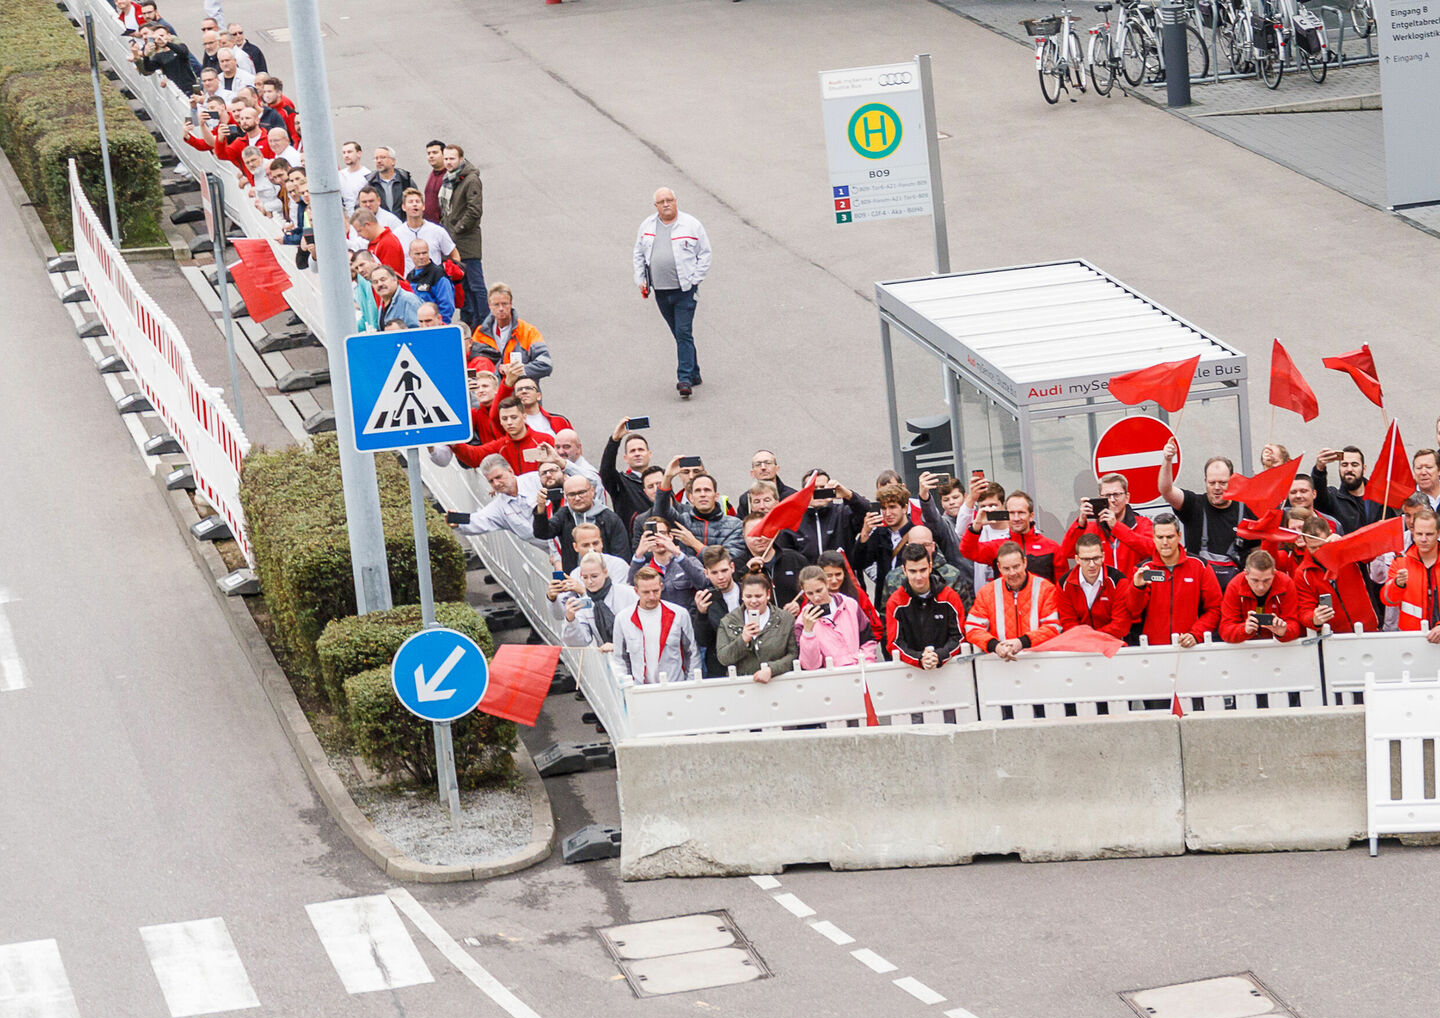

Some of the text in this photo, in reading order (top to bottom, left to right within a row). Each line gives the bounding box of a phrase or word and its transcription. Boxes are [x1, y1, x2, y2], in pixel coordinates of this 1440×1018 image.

[1390, 8, 1421, 17] Eingang
[1393, 54, 1423, 63] Eingang
[863, 115, 887, 147] H
[1028, 384, 1063, 399] Audi
[1215, 365, 1242, 376] Bus
